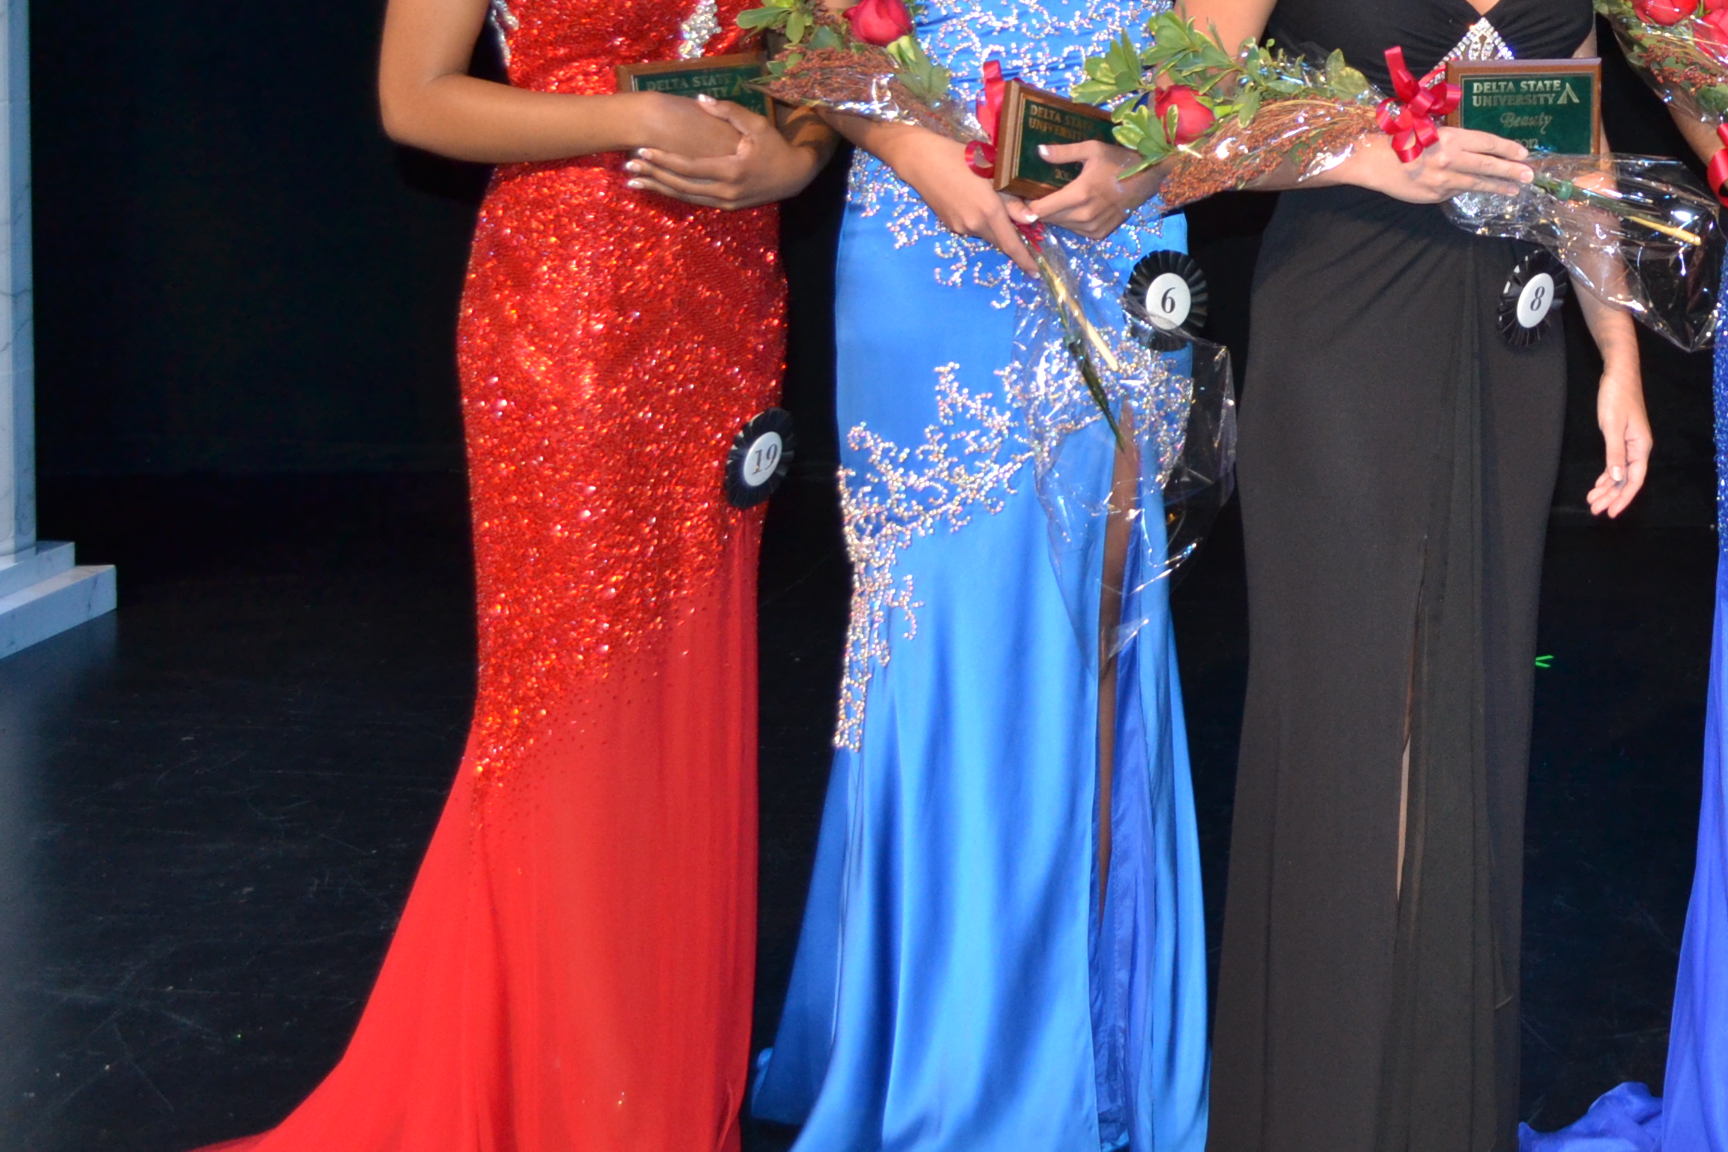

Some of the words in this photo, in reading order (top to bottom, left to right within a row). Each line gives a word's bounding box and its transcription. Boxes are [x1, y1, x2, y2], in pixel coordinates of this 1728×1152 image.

[646, 77, 689, 91] DELTA
[692, 73, 732, 88] STATE
[1472, 81, 1516, 94] DELTA
[1520, 80, 1562, 92] STATE
[1472, 93, 1556, 107] UNIVERSITY
[1030, 104, 1061, 122] DELTA
[1065, 114, 1095, 130] STATE
[1500, 112, 1553, 135] Beauty
[1028, 117, 1089, 141] UNIVERSITY
[1054, 168, 1073, 181] 201
[1161, 286, 1176, 314] 6
[1529, 285, 1546, 312] 8
[751, 443, 779, 476] 19
